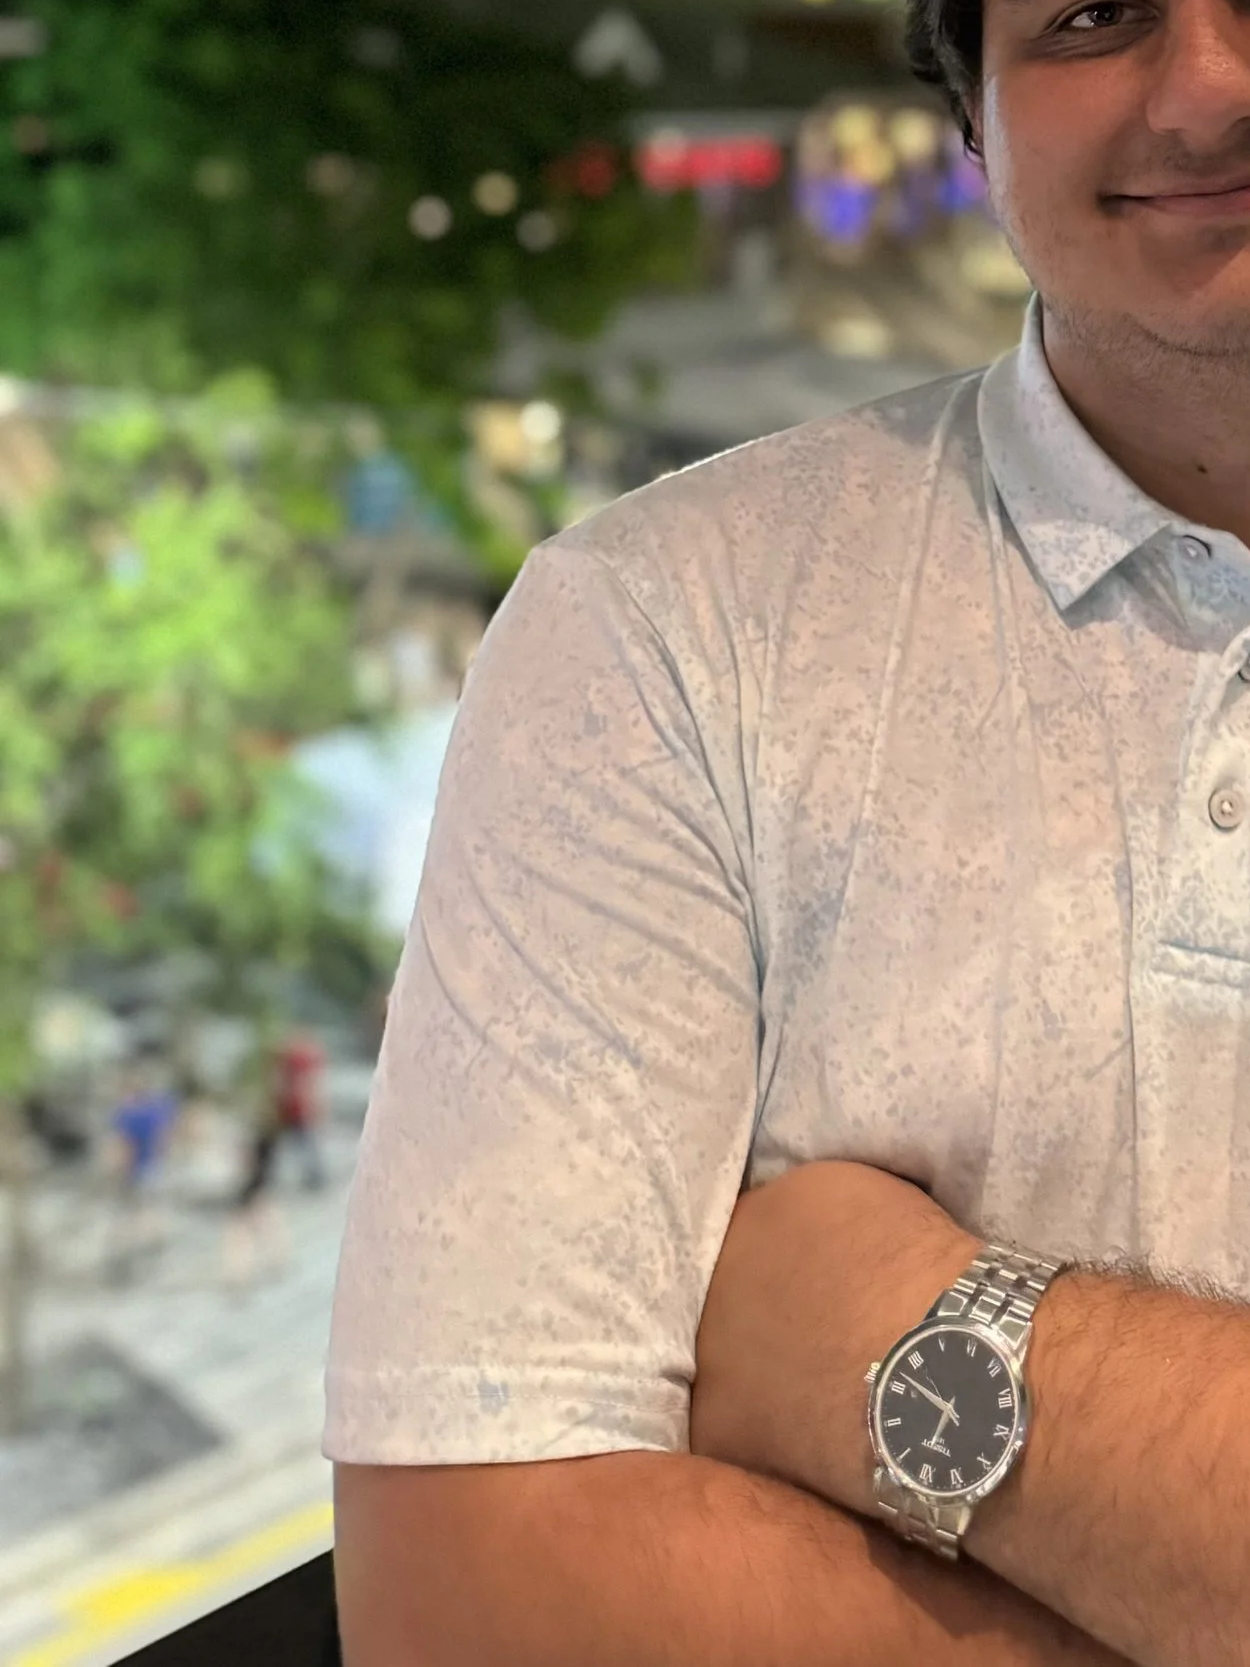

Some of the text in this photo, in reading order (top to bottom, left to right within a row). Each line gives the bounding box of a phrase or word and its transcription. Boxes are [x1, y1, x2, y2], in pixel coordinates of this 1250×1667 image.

[908, 1350, 924, 1370] IIII
[987, 1358, 1001, 1377] VII
[891, 1380, 906, 1395] III
[998, 1388, 1012, 1409] VIII
[887, 1417, 901, 1427] II
[920, 1463, 937, 1483] XII
